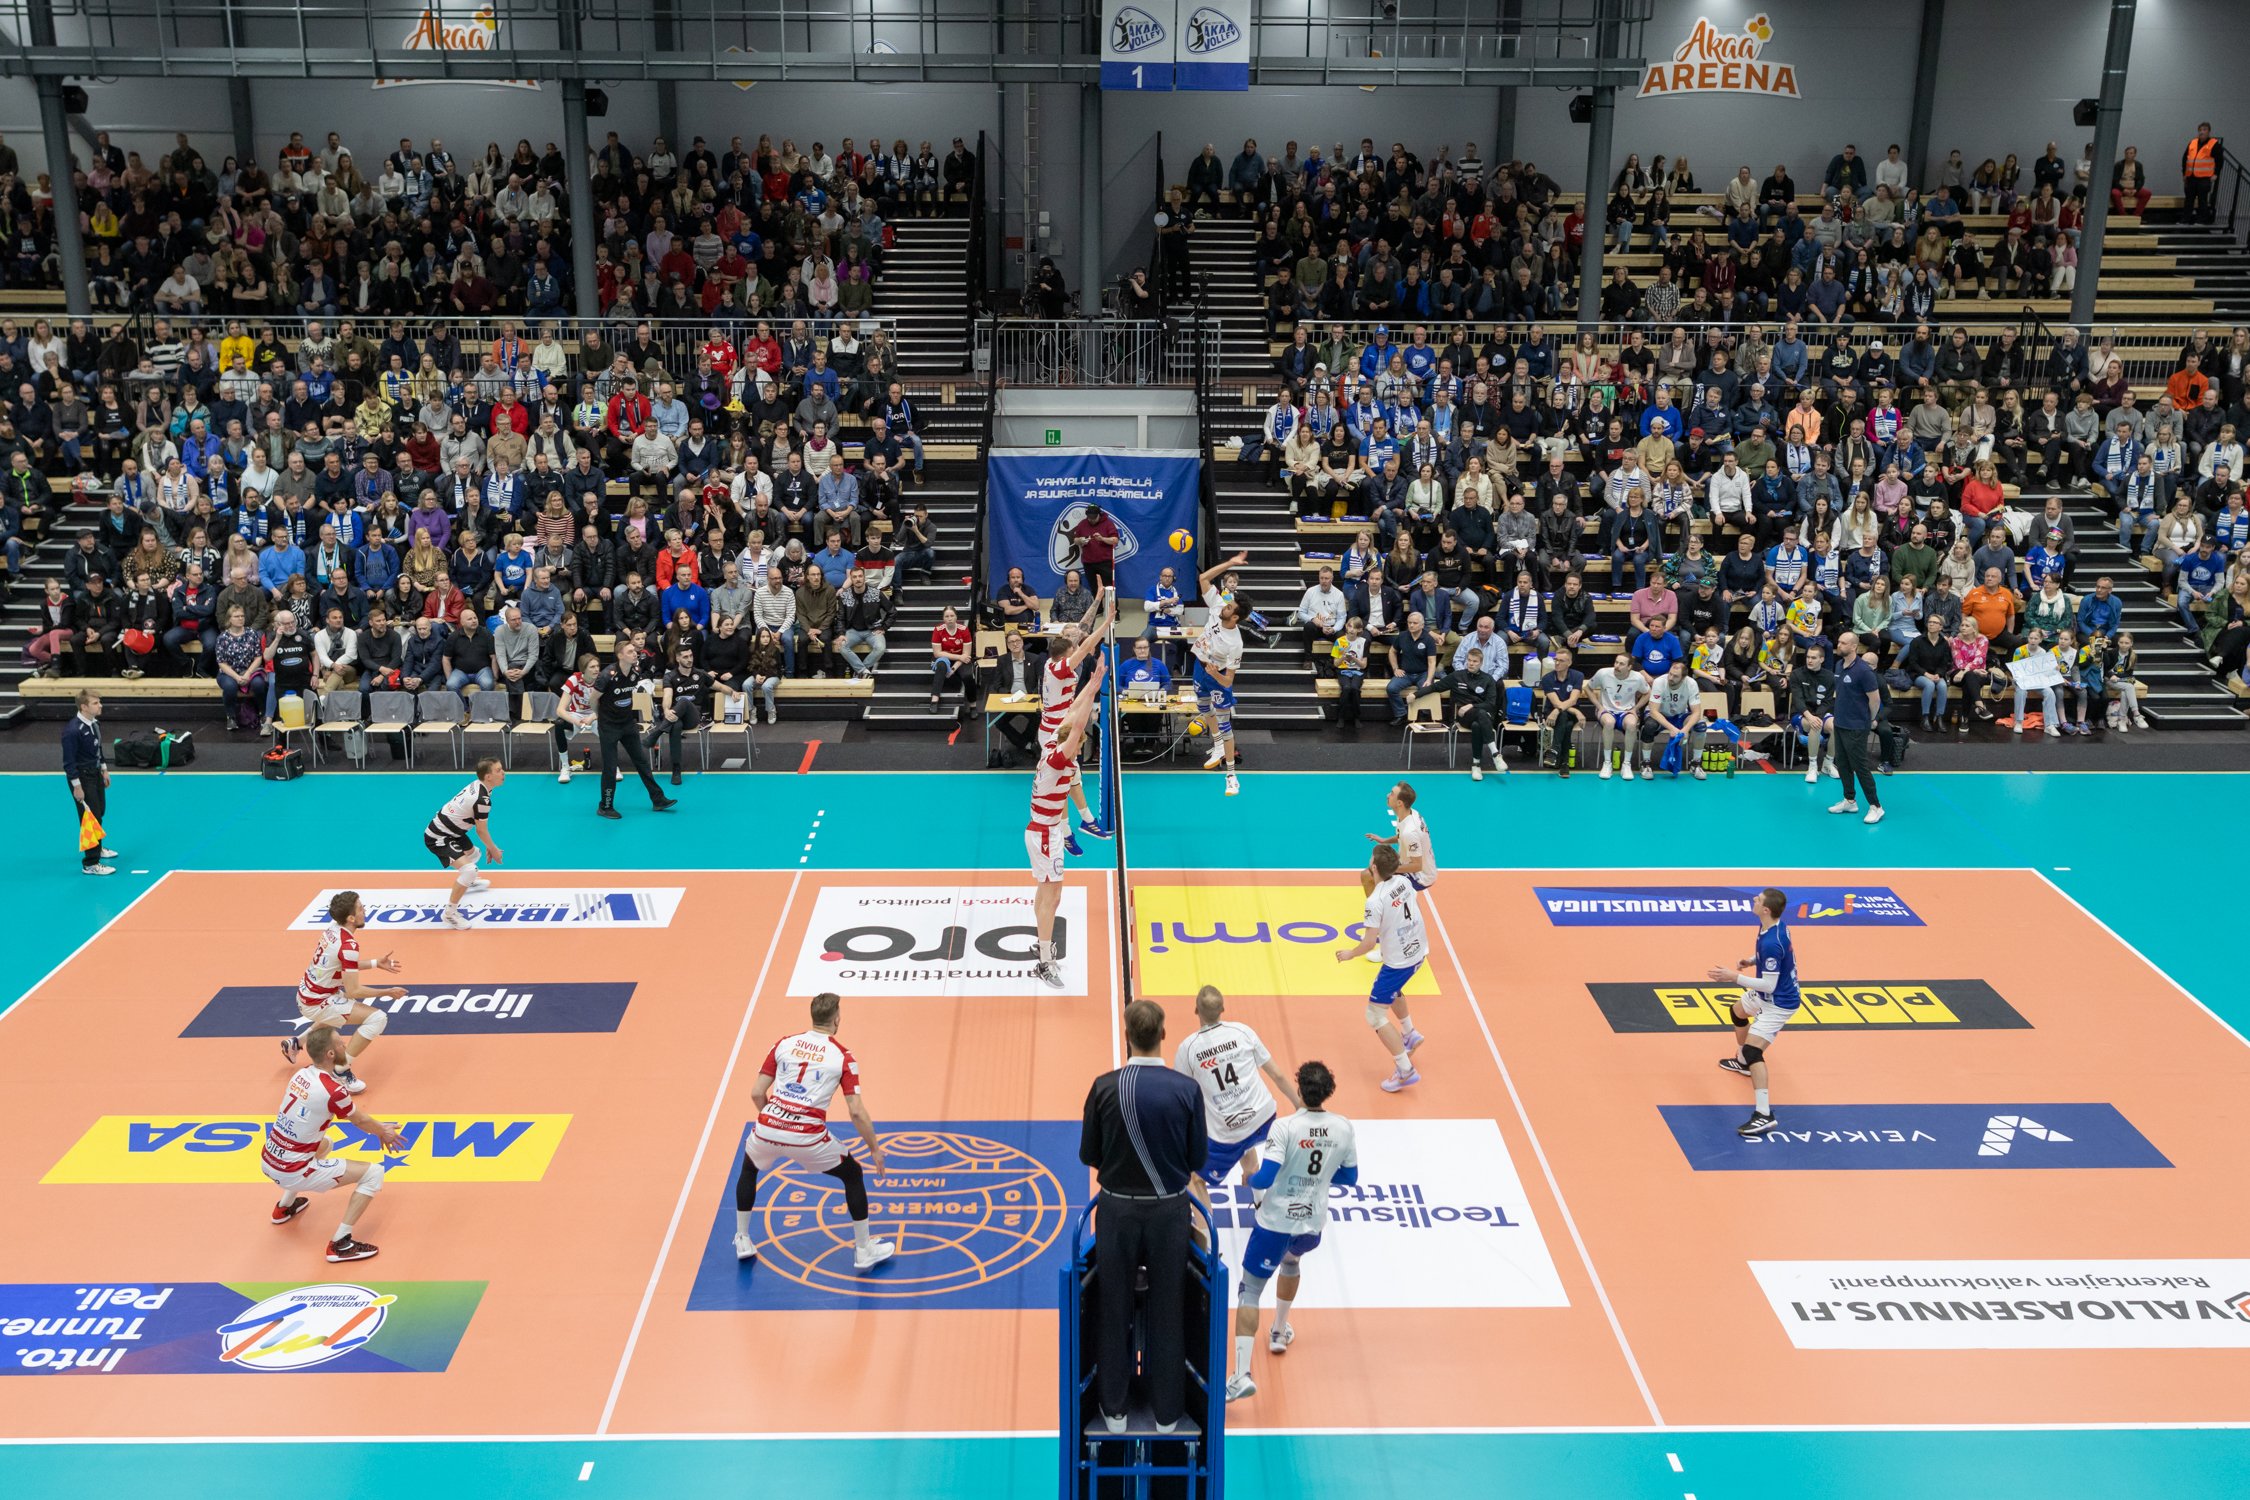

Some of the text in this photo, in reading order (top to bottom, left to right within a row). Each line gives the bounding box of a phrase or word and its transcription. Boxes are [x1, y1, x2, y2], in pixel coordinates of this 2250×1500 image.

[405, 9, 490, 50] Akaa
[1128, 24, 1159, 37] AKAA
[1204, 24, 1234, 37] AKAA
[1128, 30, 1161, 50] VOLLEY
[1204, 30, 1236, 50] VOLLEY
[1676, 20, 1760, 64] Akaa
[1132, 65, 1143, 88] 1
[1642, 63, 1797, 94] AREENA
[1036, 476, 1152, 487] VAHVALLA KÄDELLÄ
[1025, 488, 1163, 500] JA SUURELLA SYDÄMELLÄ
[2046, 557, 2055, 567] 14
[1616, 684, 1622, 693] 7
[1670, 693, 1679, 702] 18
[858, 897, 952, 907] proliitto.fi
[962, 897, 1034, 907] itypro.fi
[1548, 900, 1753, 913] MESTARUUSLIIGA
[1404, 902, 1412, 920] 4
[1869, 909, 1910, 917] Into.
[824, 916, 1067, 961] pro
[1666, 991, 1936, 1008] PONSE
[795, 1039, 827, 1054] SIVULA
[1196, 1040, 1239, 1061] SINKKONEN
[791, 1048, 824, 1063] renta
[796, 1062, 809, 1084] 1
[1211, 1062, 1239, 1091] 14
[295, 1075, 311, 1089] ESKO
[283, 1093, 298, 1114] 7
[128, 1121, 534, 1157] MIKSA
[1740, 1130, 1937, 1143] VEIKKAUS
[1307, 1150, 1323, 1175] 8
[873, 1178, 947, 1188] IMATRA
[789, 1190, 807, 1203] 3
[1327, 1184, 1425, 1204] liitto
[832, 1201, 978, 1215] POWER CP
[783, 1214, 802, 1227] 2
[1003, 1214, 1021, 1226] 2
[1829, 1275, 2211, 1291] Rakentajien valiokumppani!
[75, 1288, 174, 1311] Peli.
[1791, 1300, 2236, 1321] VALIOASENNUS.FI
[0, 1317, 146, 1340] Tunne.
[15, 1348, 128, 1373] Into.
